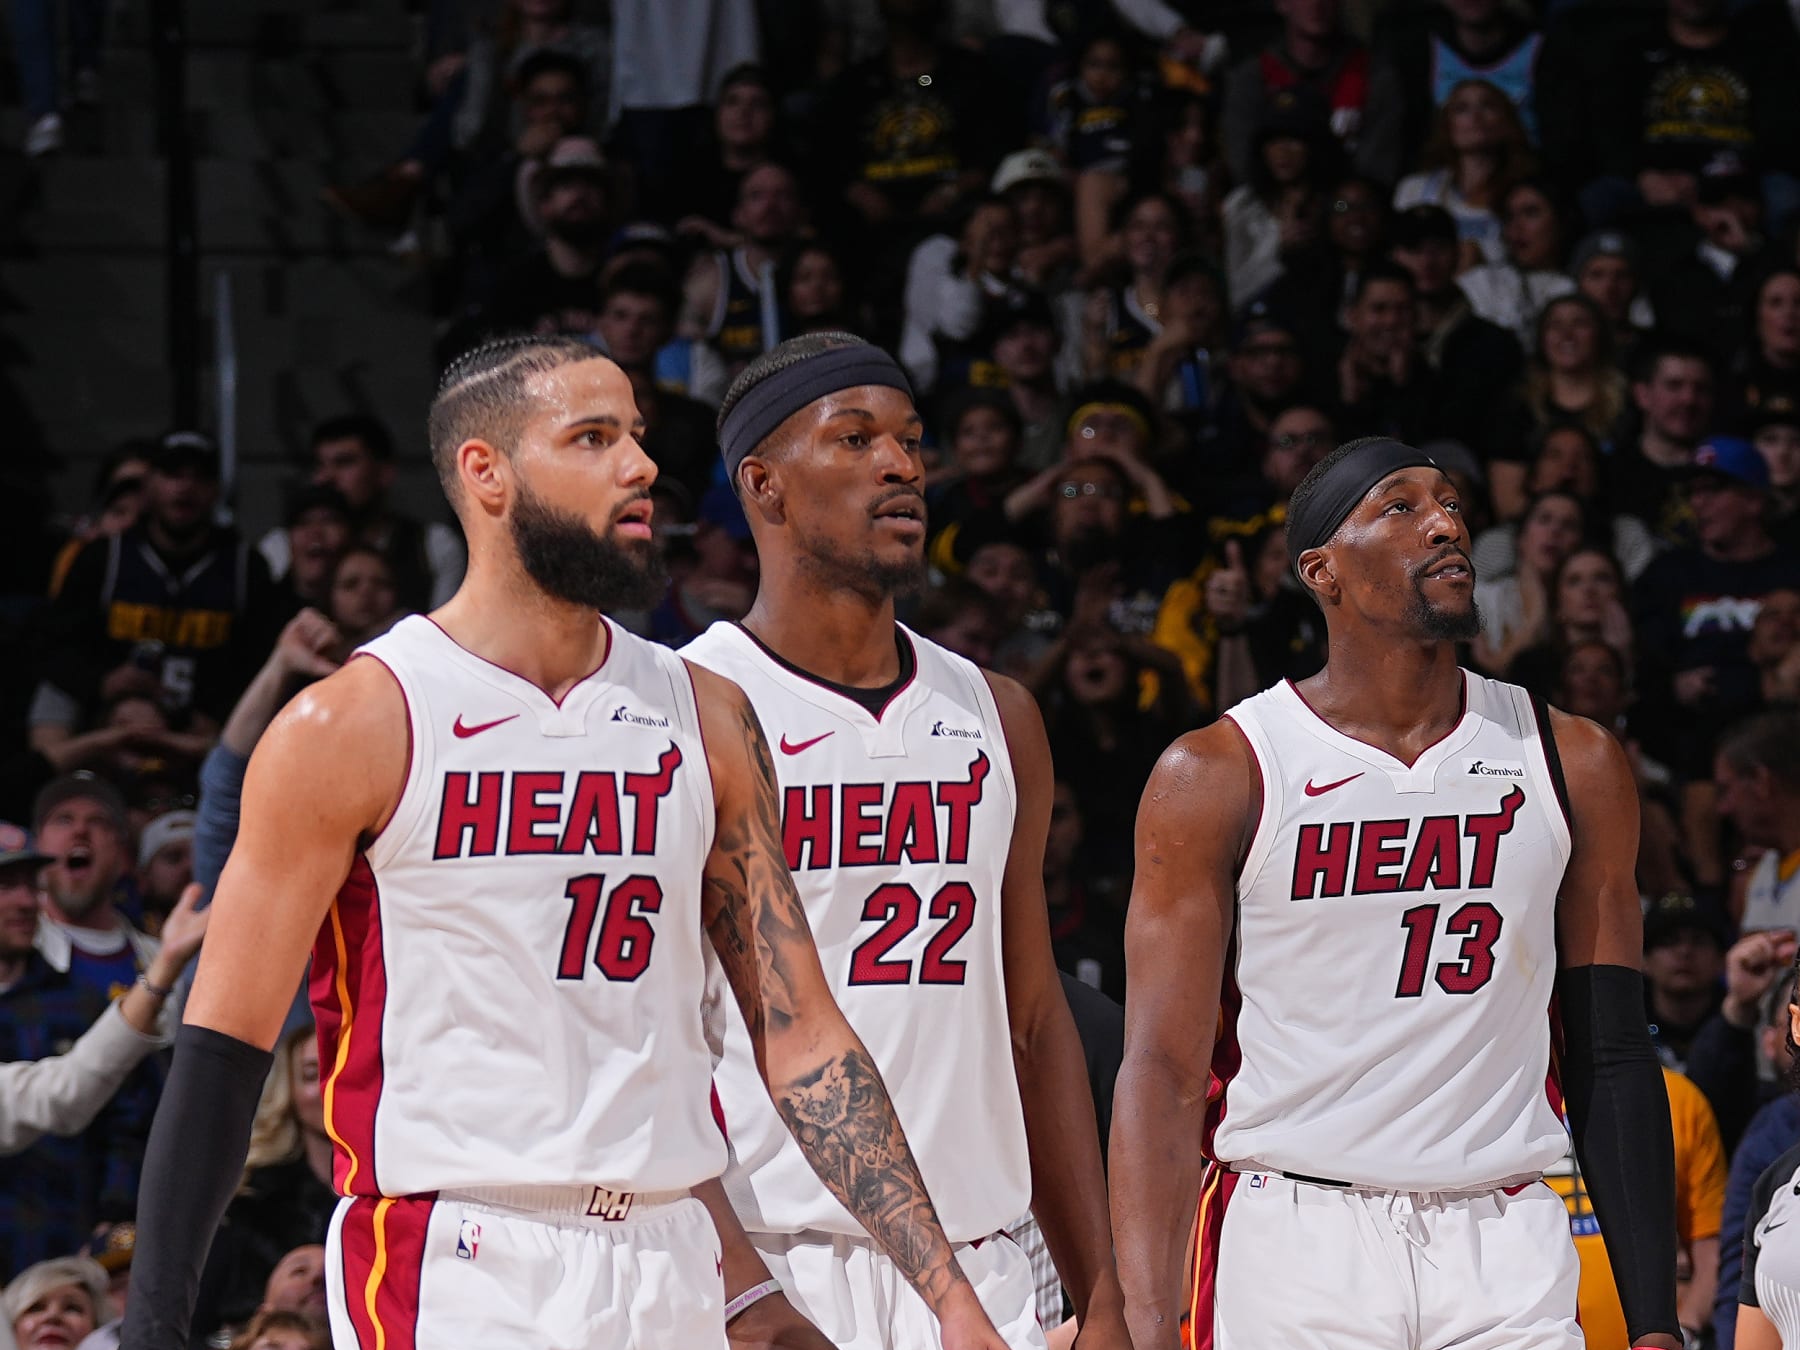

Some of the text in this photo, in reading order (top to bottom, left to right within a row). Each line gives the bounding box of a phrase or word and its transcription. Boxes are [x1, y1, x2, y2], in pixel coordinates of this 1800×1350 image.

[624, 713, 669, 728] Carnival
[941, 727, 982, 739] Carnival
[1480, 766, 1523, 777] Carnival
[433, 740, 683, 861] HEAT
[782, 748, 990, 871] HEAT
[1291, 784, 1526, 901] HEAT
[556, 873, 664, 982] 16
[848, 881, 977, 986] 22
[1395, 902, 1504, 998] 13
